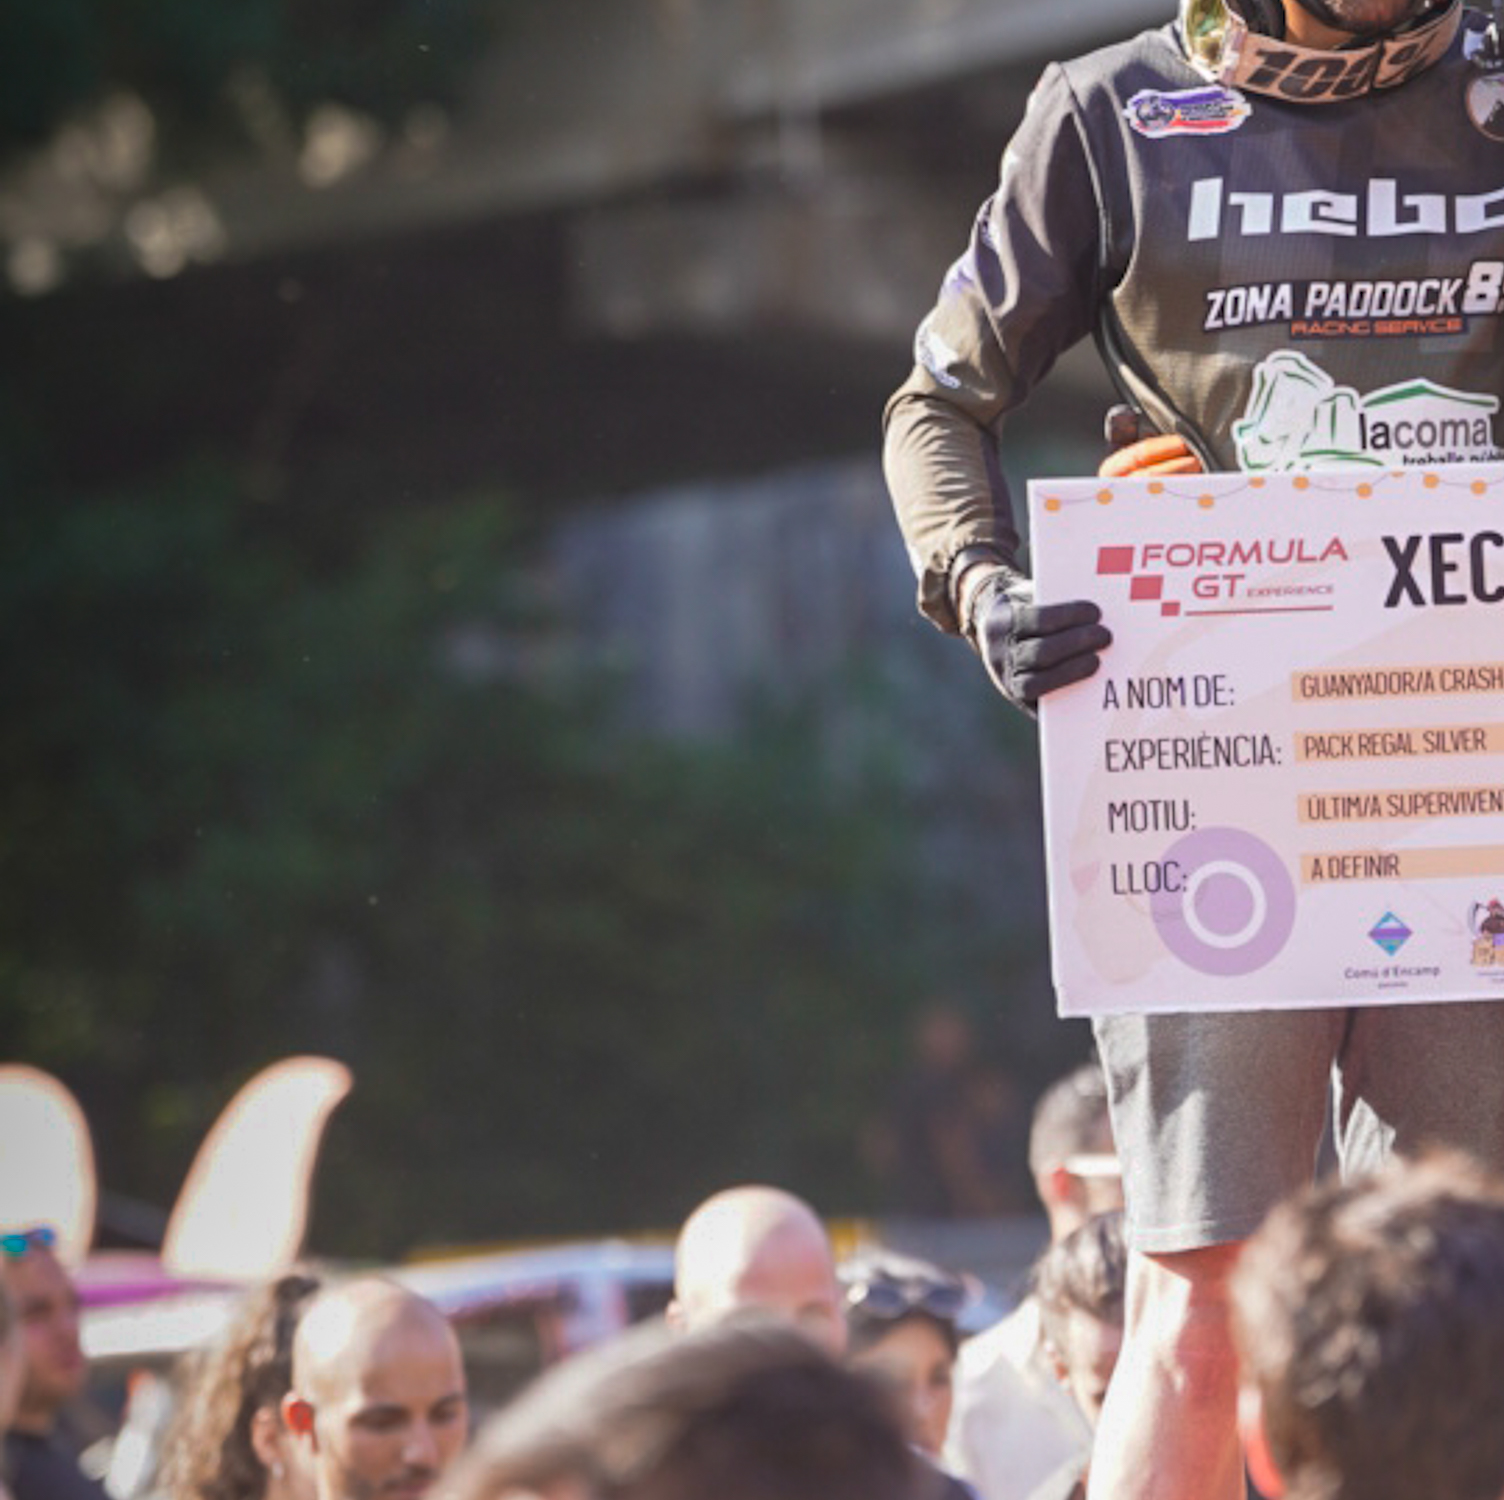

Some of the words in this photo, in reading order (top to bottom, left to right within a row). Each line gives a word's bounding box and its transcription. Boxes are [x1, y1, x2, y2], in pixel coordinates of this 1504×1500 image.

[1204, 283, 1292, 331] ZONA
[1305, 277, 1462, 318] PADDOCK
[1290, 320, 1371, 337] RACING
[1374, 318, 1462, 335] SERVICE
[1359, 412, 1488, 450] lacoma
[1141, 536, 1349, 568] FORMULA
[1192, 573, 1246, 598] GT
[1247, 584, 1334, 598] EXPERIENCE
[1103, 678, 1120, 710] A
[1127, 675, 1187, 709] NOM
[1193, 674, 1235, 707] DE:
[1301, 669, 1435, 698] GUANYADOR/A
[1439, 666, 1503, 692] CRASH
[1105, 730, 1282, 773] EXPERIÈNCIA:
[1305, 734, 1354, 759] PACK
[1358, 731, 1418, 756] REGAL
[1423, 728, 1487, 753] SILVER
[1108, 799, 1196, 834] MOTIU:
[1111, 861, 1188, 895] LLOC:
[1311, 856, 1324, 880] A
[1328, 853, 1400, 880] DEFINIR
